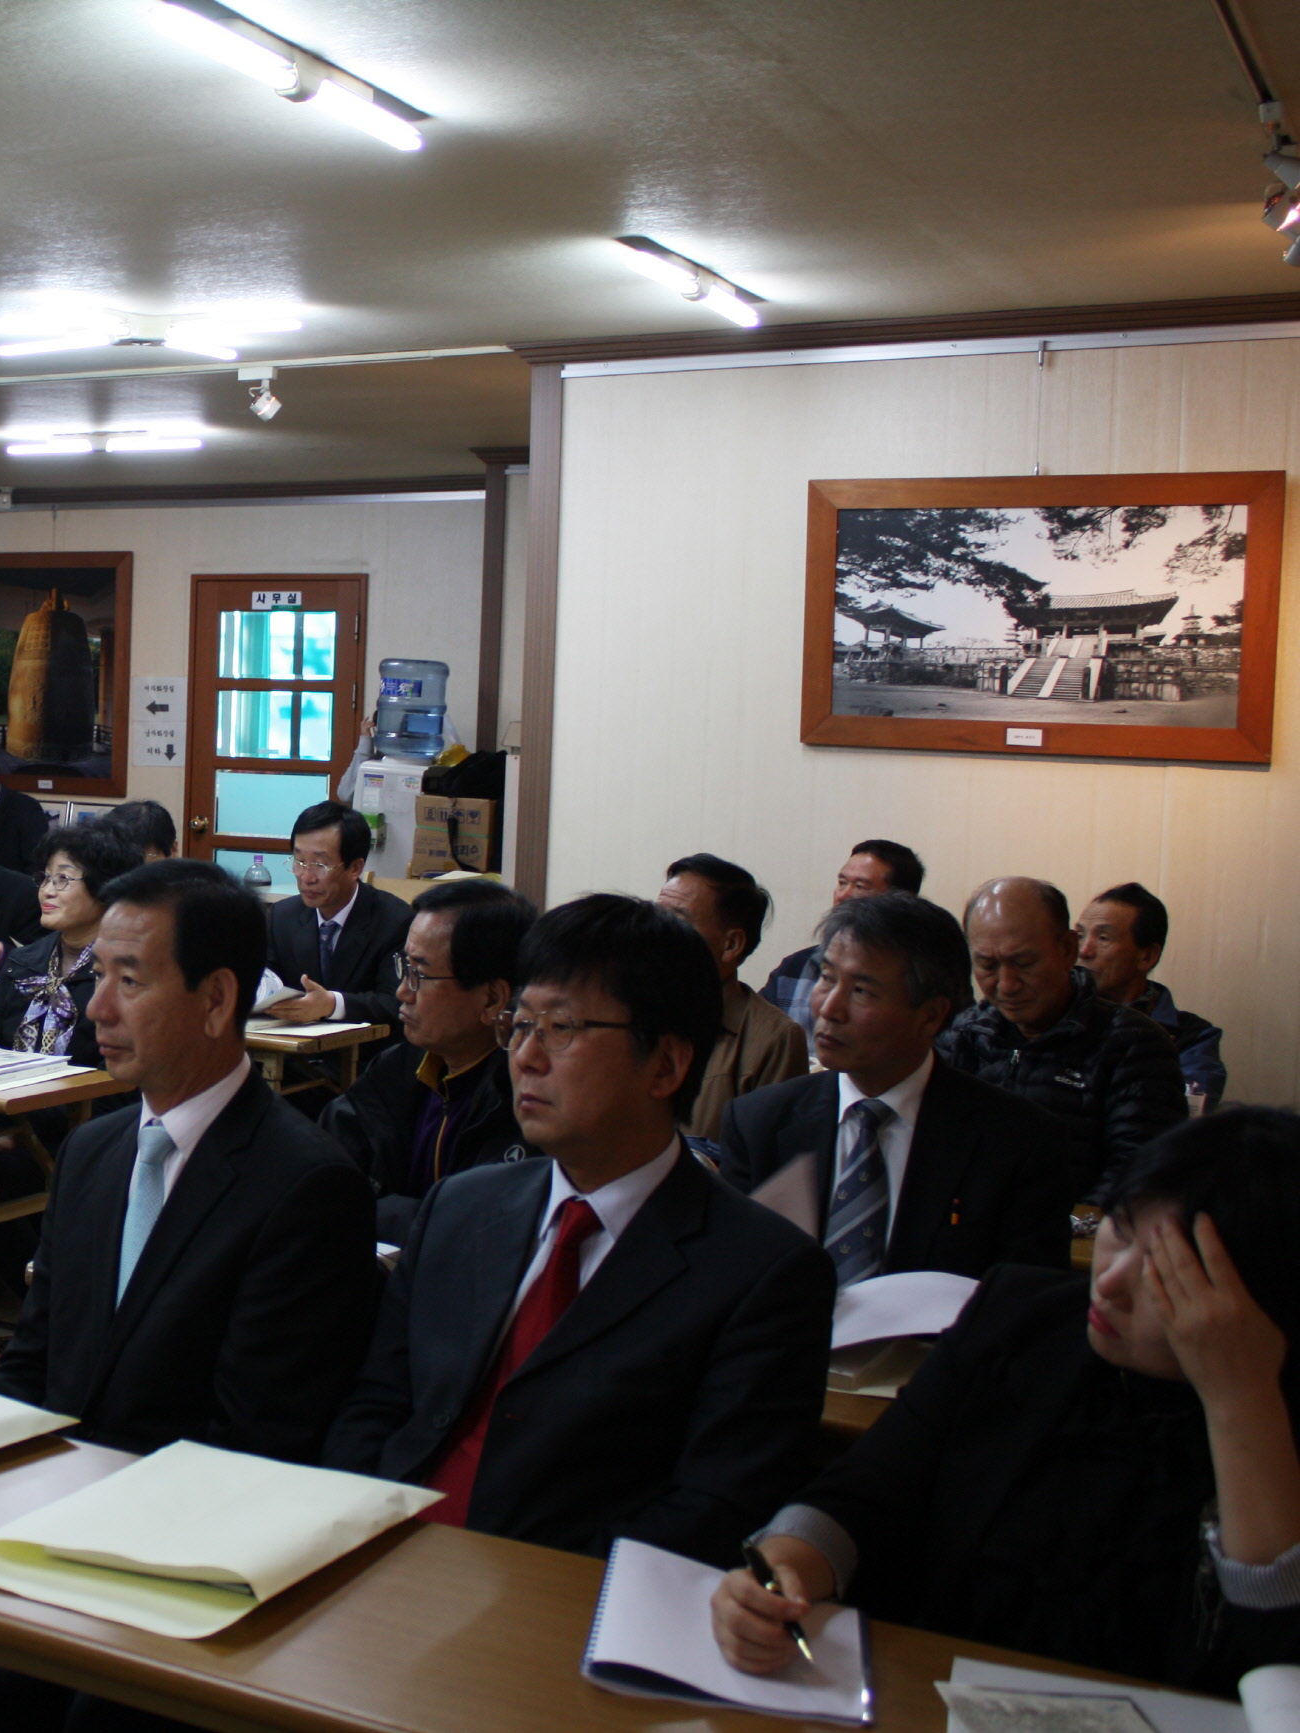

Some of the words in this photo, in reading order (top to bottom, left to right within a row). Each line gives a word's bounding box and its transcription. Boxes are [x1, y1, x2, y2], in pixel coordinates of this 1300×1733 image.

[256, 593, 297, 604] 사무실
[144, 684, 175, 693] 여자화장실
[144, 729, 175, 738] 남자화장실
